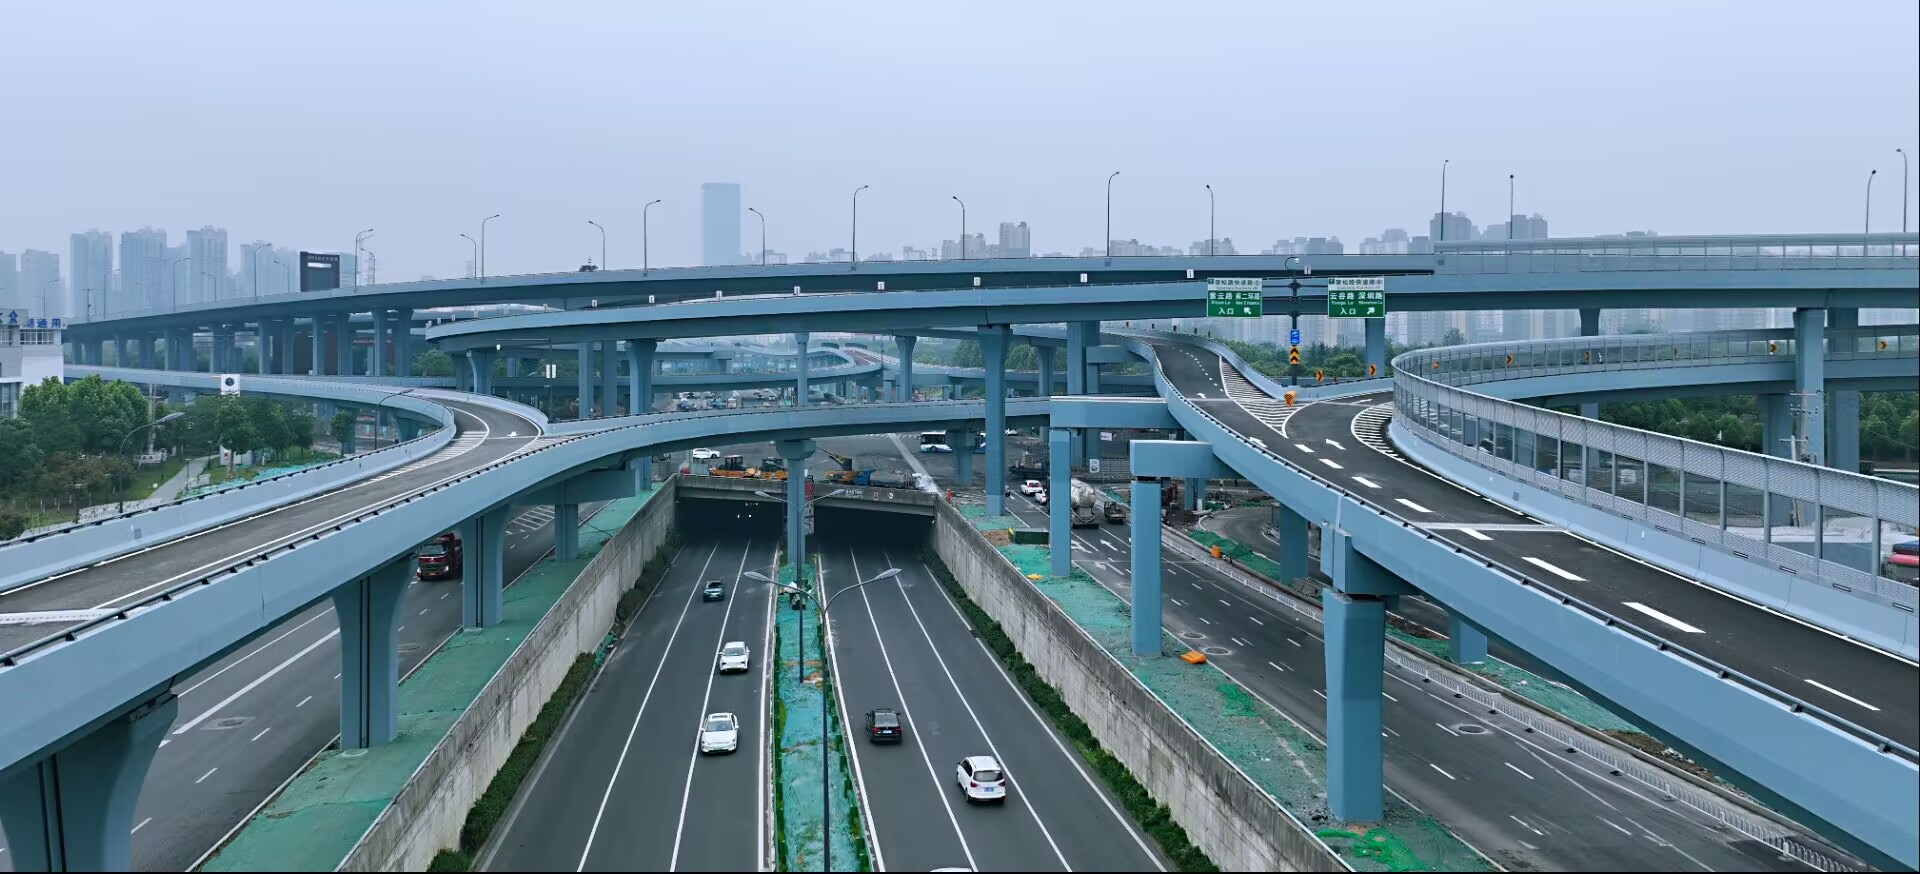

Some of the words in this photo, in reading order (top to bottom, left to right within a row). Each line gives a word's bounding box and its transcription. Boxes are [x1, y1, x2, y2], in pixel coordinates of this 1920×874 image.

[1329, 292, 1355, 300] 云谷路
[1358, 292, 1383, 300] 深圳路
[1218, 307, 1234, 315] 入口
[1340, 307, 1356, 315] 入口
